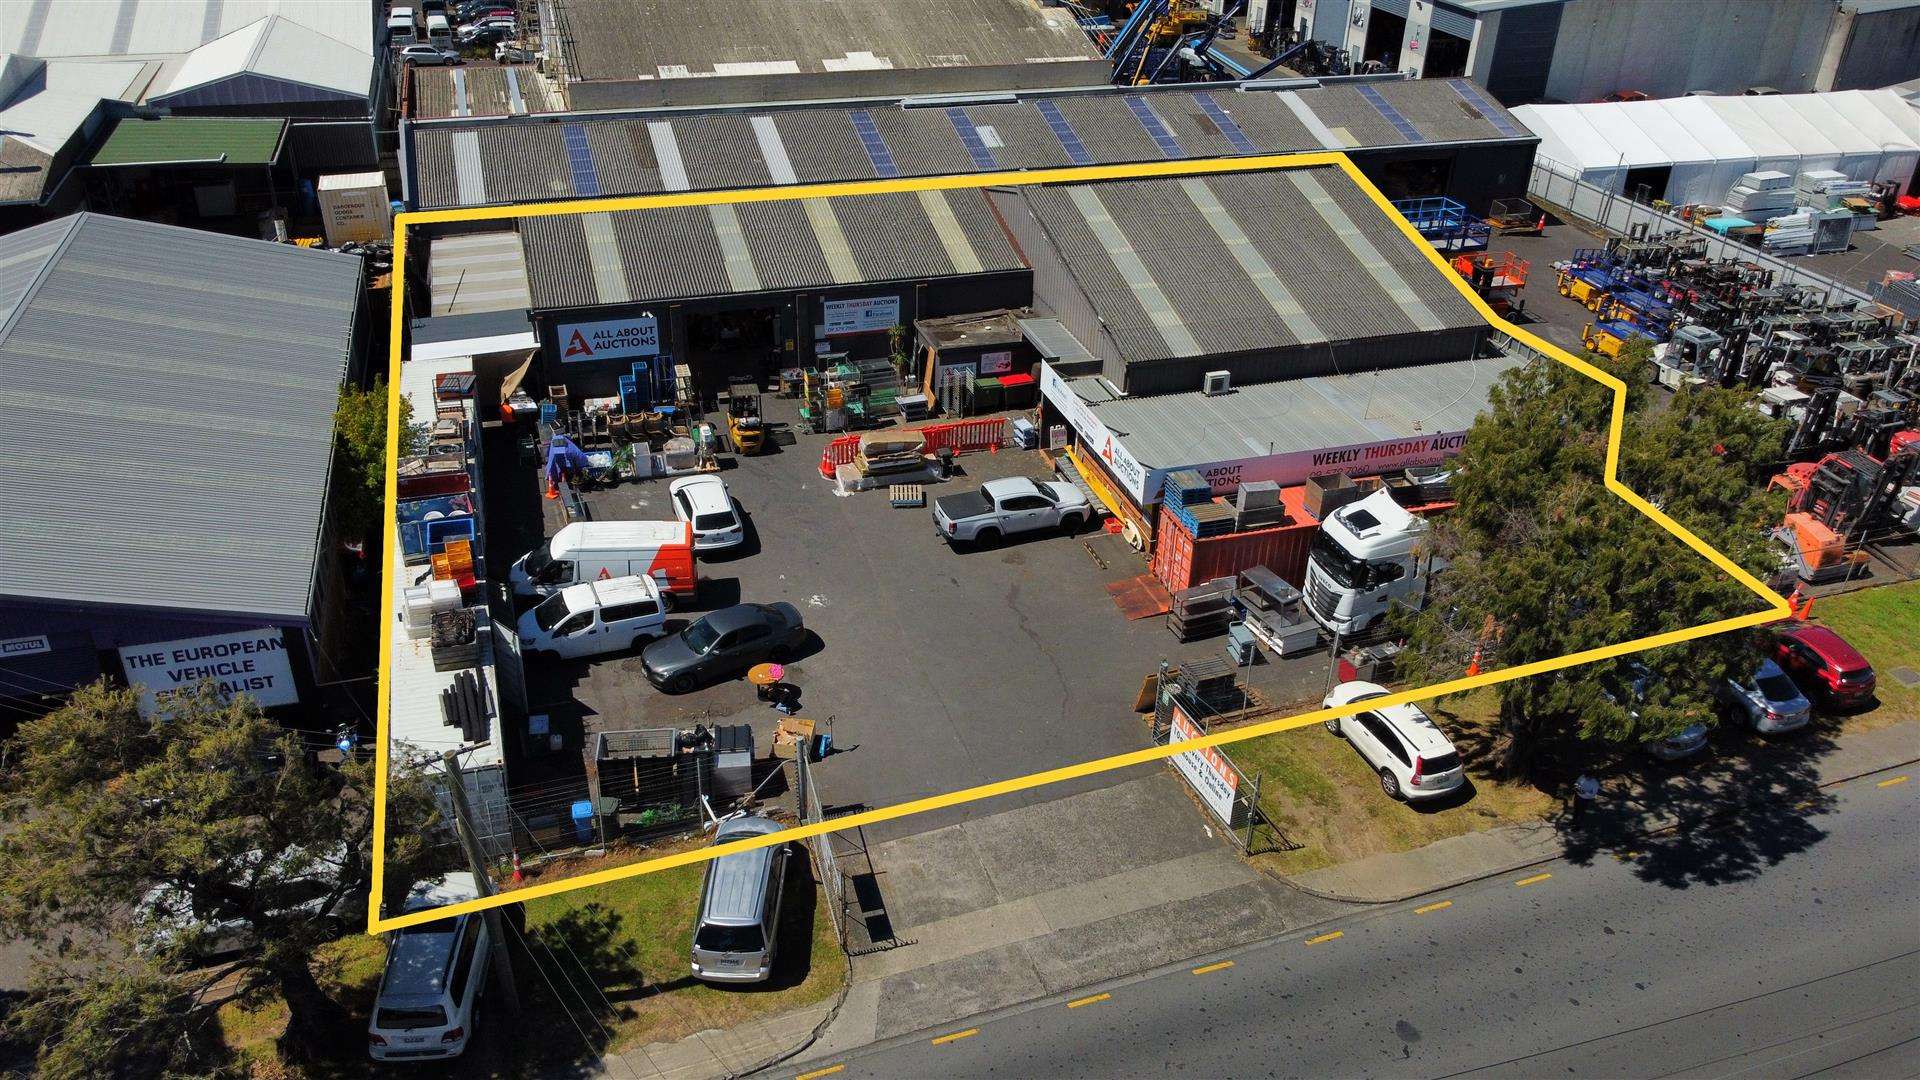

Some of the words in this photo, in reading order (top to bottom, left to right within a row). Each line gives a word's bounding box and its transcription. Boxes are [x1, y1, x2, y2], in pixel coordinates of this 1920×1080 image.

[593, 330, 613, 340] ALL
[616, 326, 655, 337] ABOUT
[594, 336, 656, 350] AUCTIONS
[1312, 449, 1361, 466] WEEKLY
[1364, 439, 1430, 460] THURSDAY
[1205, 465, 1243, 477] ABOUT
[1206, 475, 1241, 487] TIONS
[5, 641, 42, 651] MOTUL
[126, 652, 166, 669] THE
[172, 637, 285, 663] EUROPEAN
[167, 660, 256, 682] VEHICLE
[1205, 764, 1231, 799] Thursday
